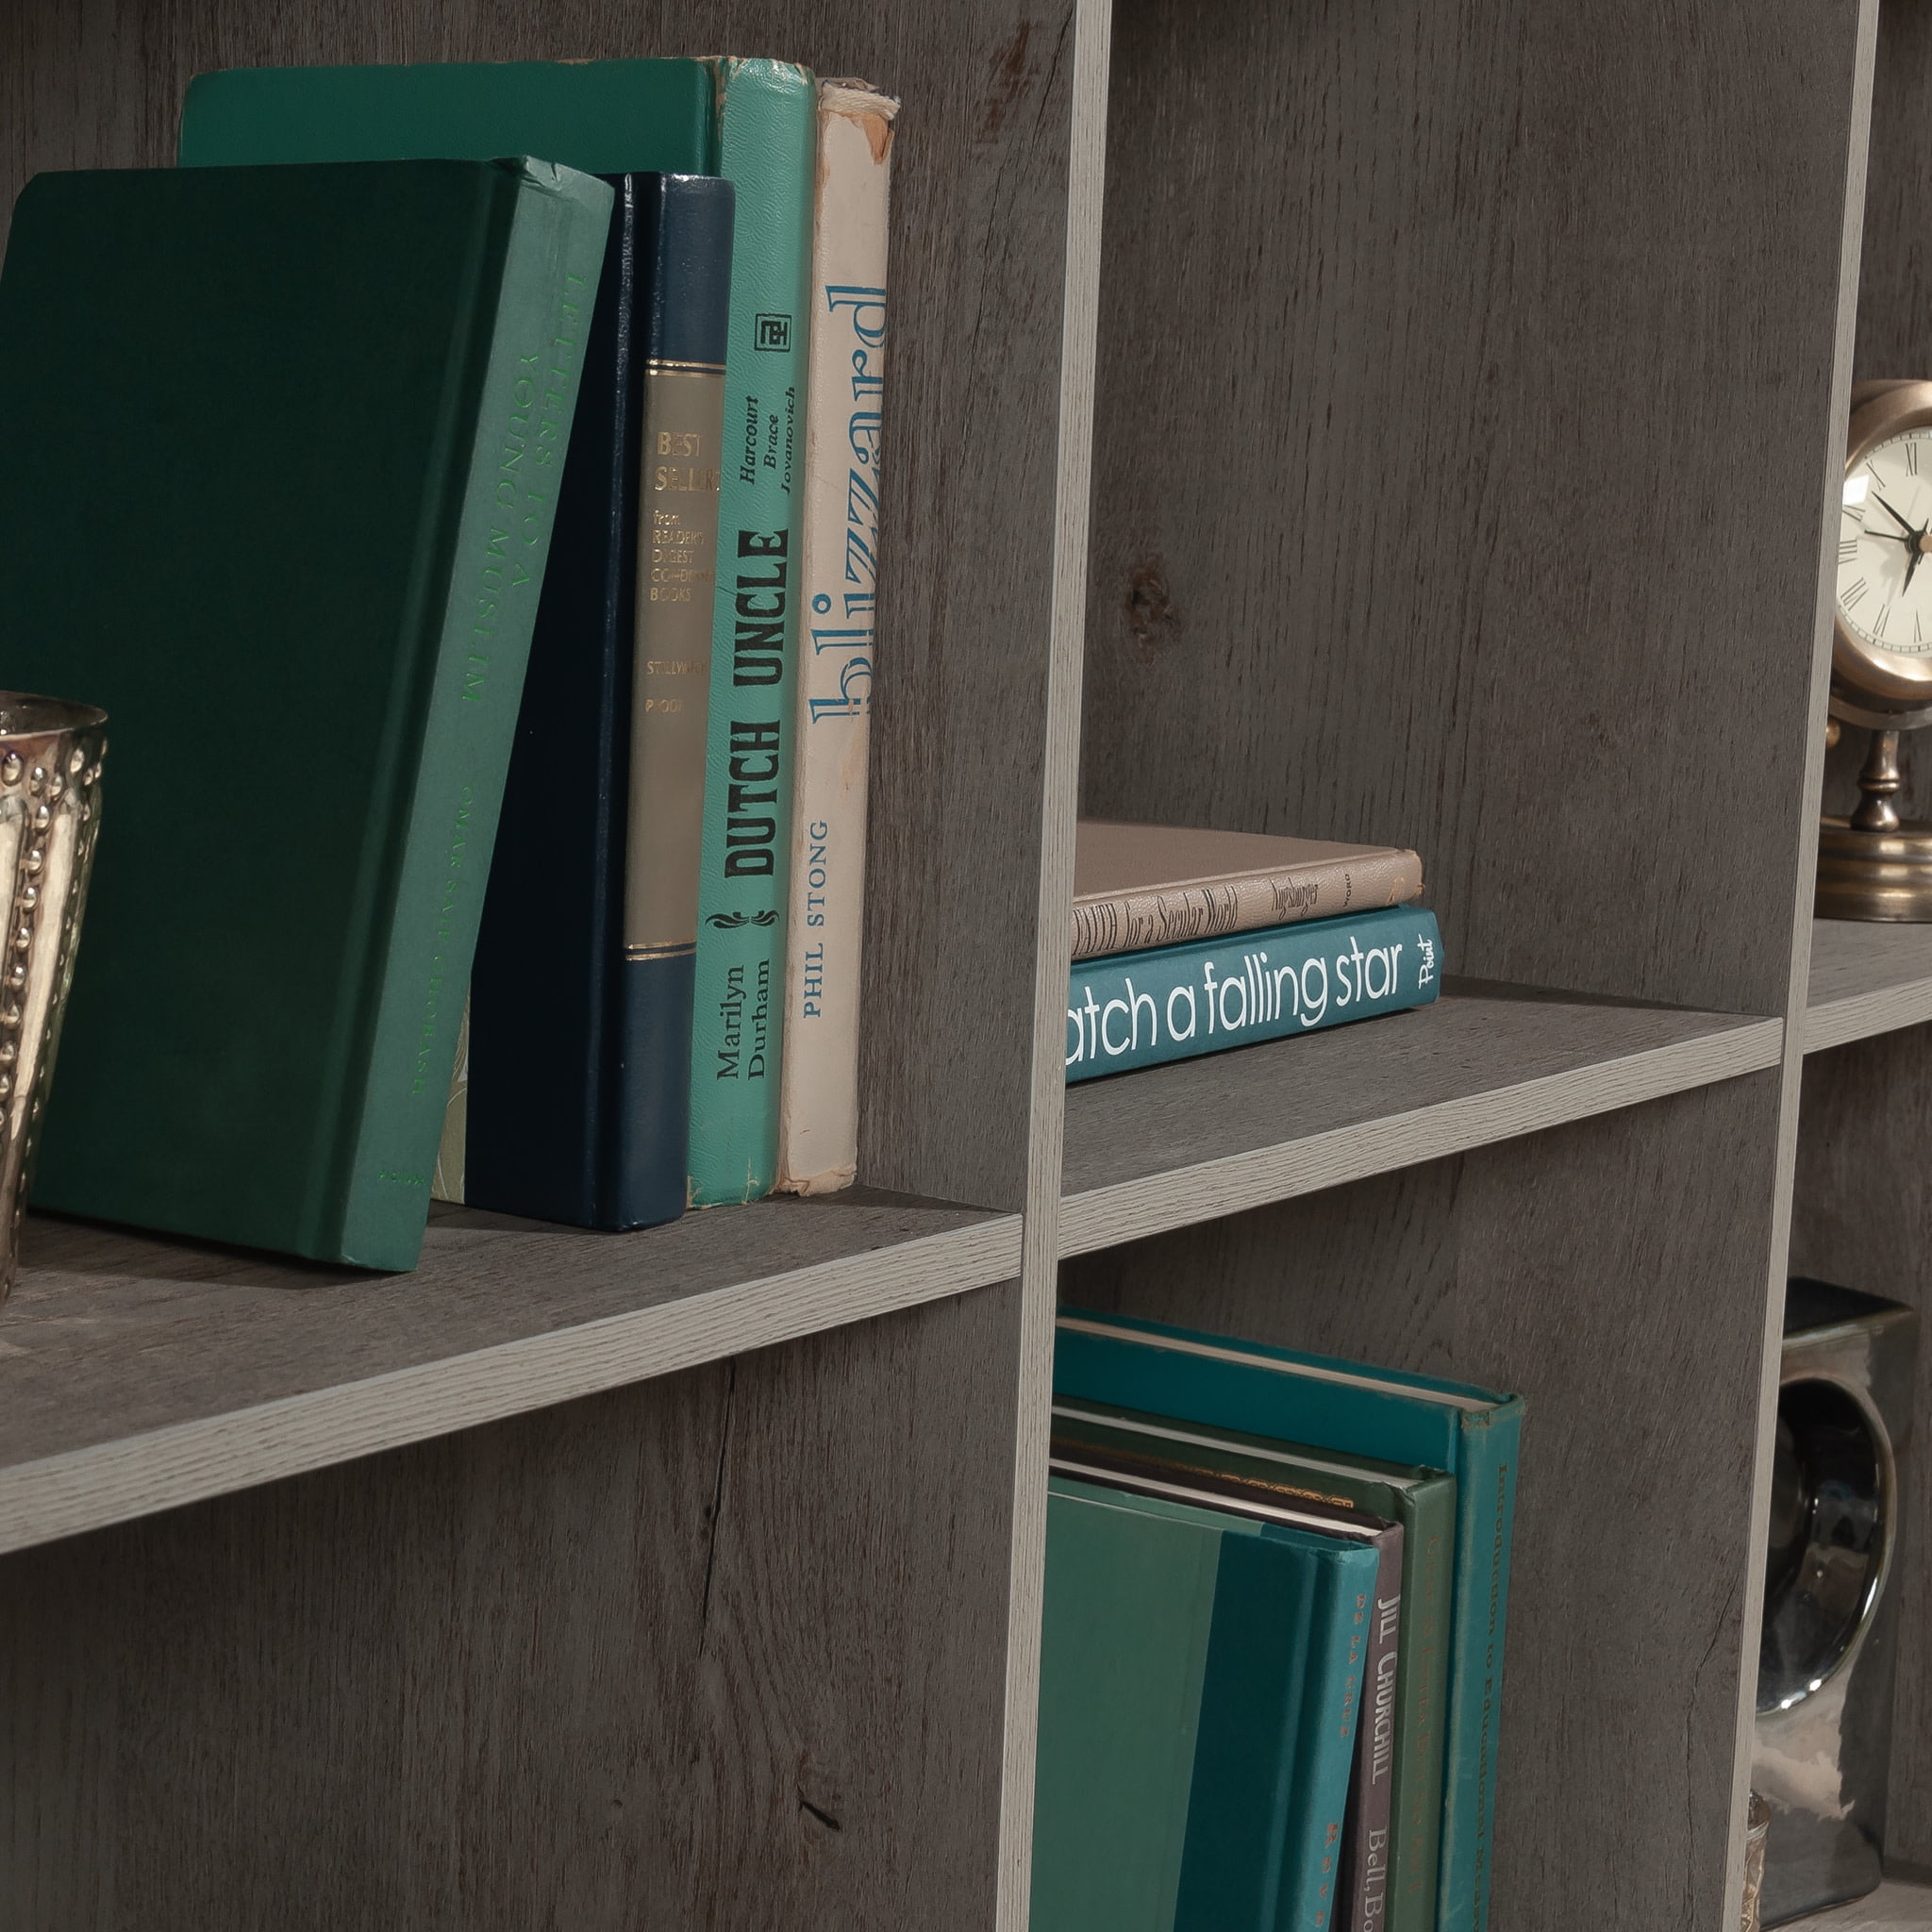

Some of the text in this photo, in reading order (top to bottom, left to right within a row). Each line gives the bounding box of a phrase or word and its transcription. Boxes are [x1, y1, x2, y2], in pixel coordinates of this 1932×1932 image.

[511, 272, 587, 587] LETTERS TO A
[657, 431, 704, 457] BEST
[740, 395, 758, 485] Harcourt
[763, 414, 779, 470] Brace
[781, 385, 795, 497] Jovanovich
[461, 353, 540, 703] YOUNG MUSLIM
[808, 285, 887, 724] blizzard
[724, 528, 789, 878] DUTCH UNCLE
[804, 820, 828, 1018] PHIL STONG
[1124, 900, 1143, 948] for
[1144, 914, 1154, 944] a
[1157, 892, 1204, 943] Secular
[1202, 885, 1239, 934] World
[1342, 874, 1353, 908] WORD
[1167, 985, 1196, 1041] a
[1204, 952, 1327, 1036] falling
[1336, 936, 1404, 1008] star
[1418, 933, 1435, 990] Point
[717, 964, 747, 1081] Marilyn
[748, 958, 771, 1082] Durham
[1489, 1464, 1507, 1635] Introduction
[1348, 1637, 1360, 1664] LA
[1354, 1594, 1368, 1624] DE
[1486, 1643, 1494, 1669] to
[1372, 1594, 1401, 1785] JILL CHURCHILL
[1477, 1677, 1491, 1840] Educational
[1366, 1827, 1386, 1891] Bell,
